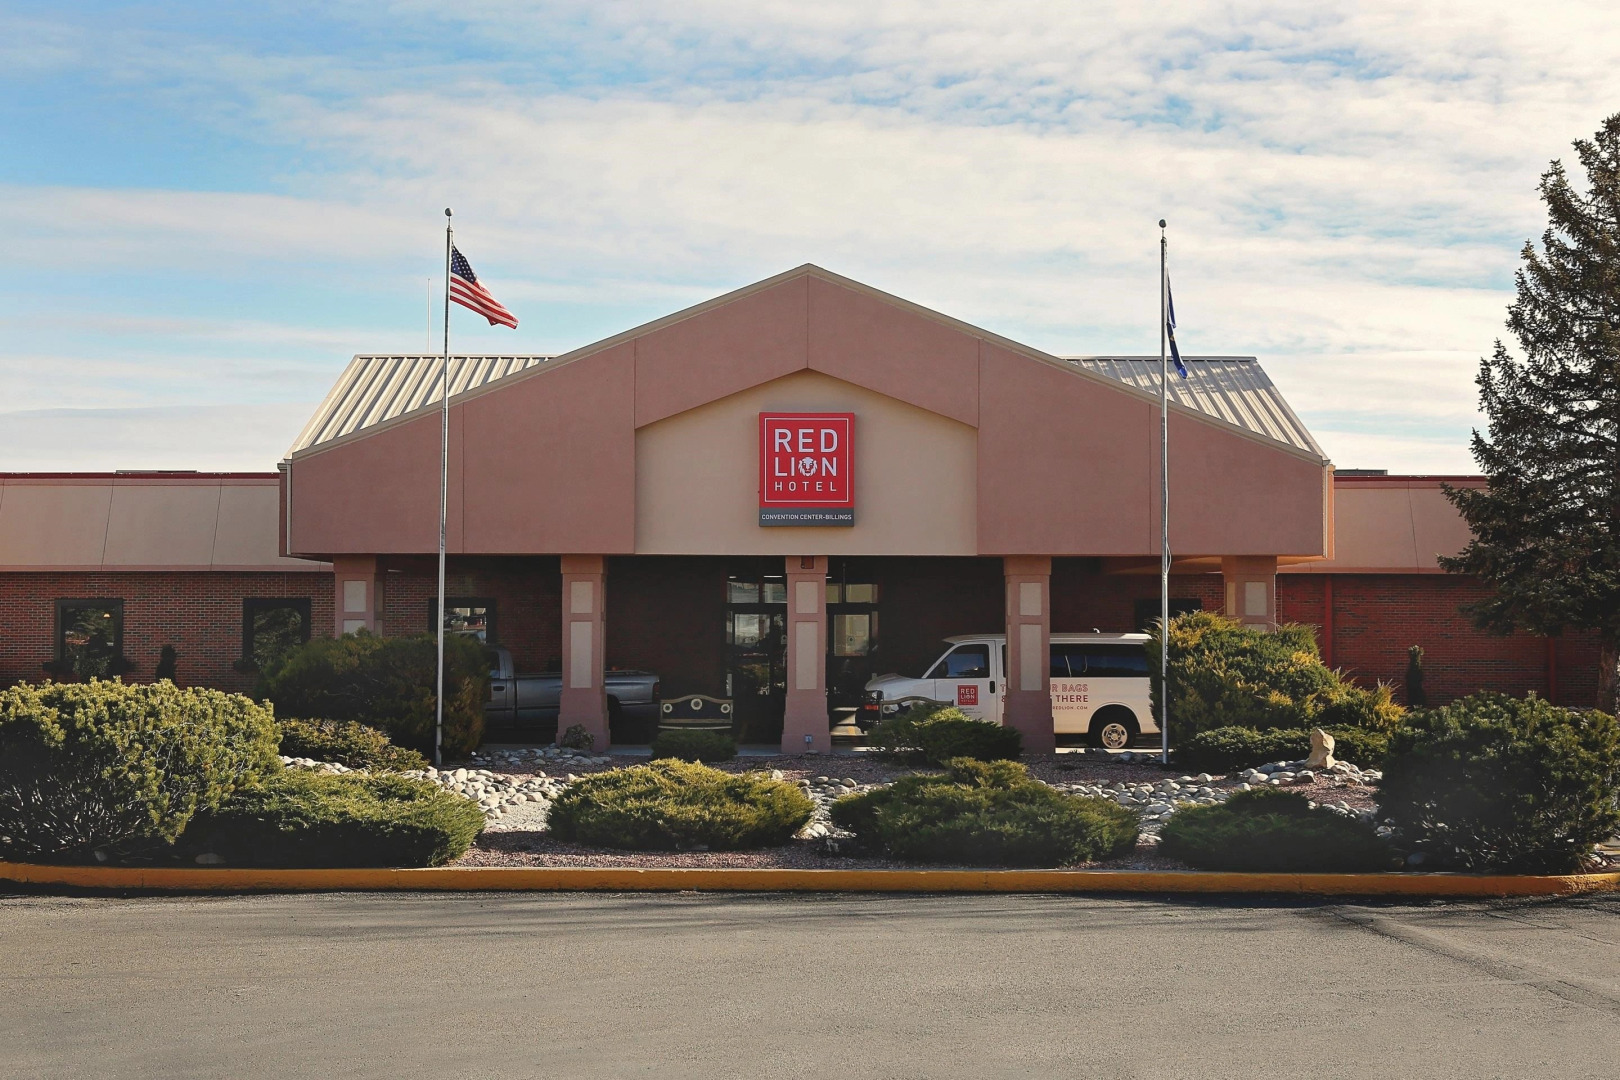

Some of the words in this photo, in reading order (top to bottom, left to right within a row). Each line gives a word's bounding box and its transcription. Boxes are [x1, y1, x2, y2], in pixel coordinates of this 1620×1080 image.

[774, 428, 838, 453] RED
[774, 456, 837, 477] LION
[774, 481, 837, 492] HOTEL
[1061, 683, 1089, 692] BAGS
[1055, 694, 1089, 703] THERE
